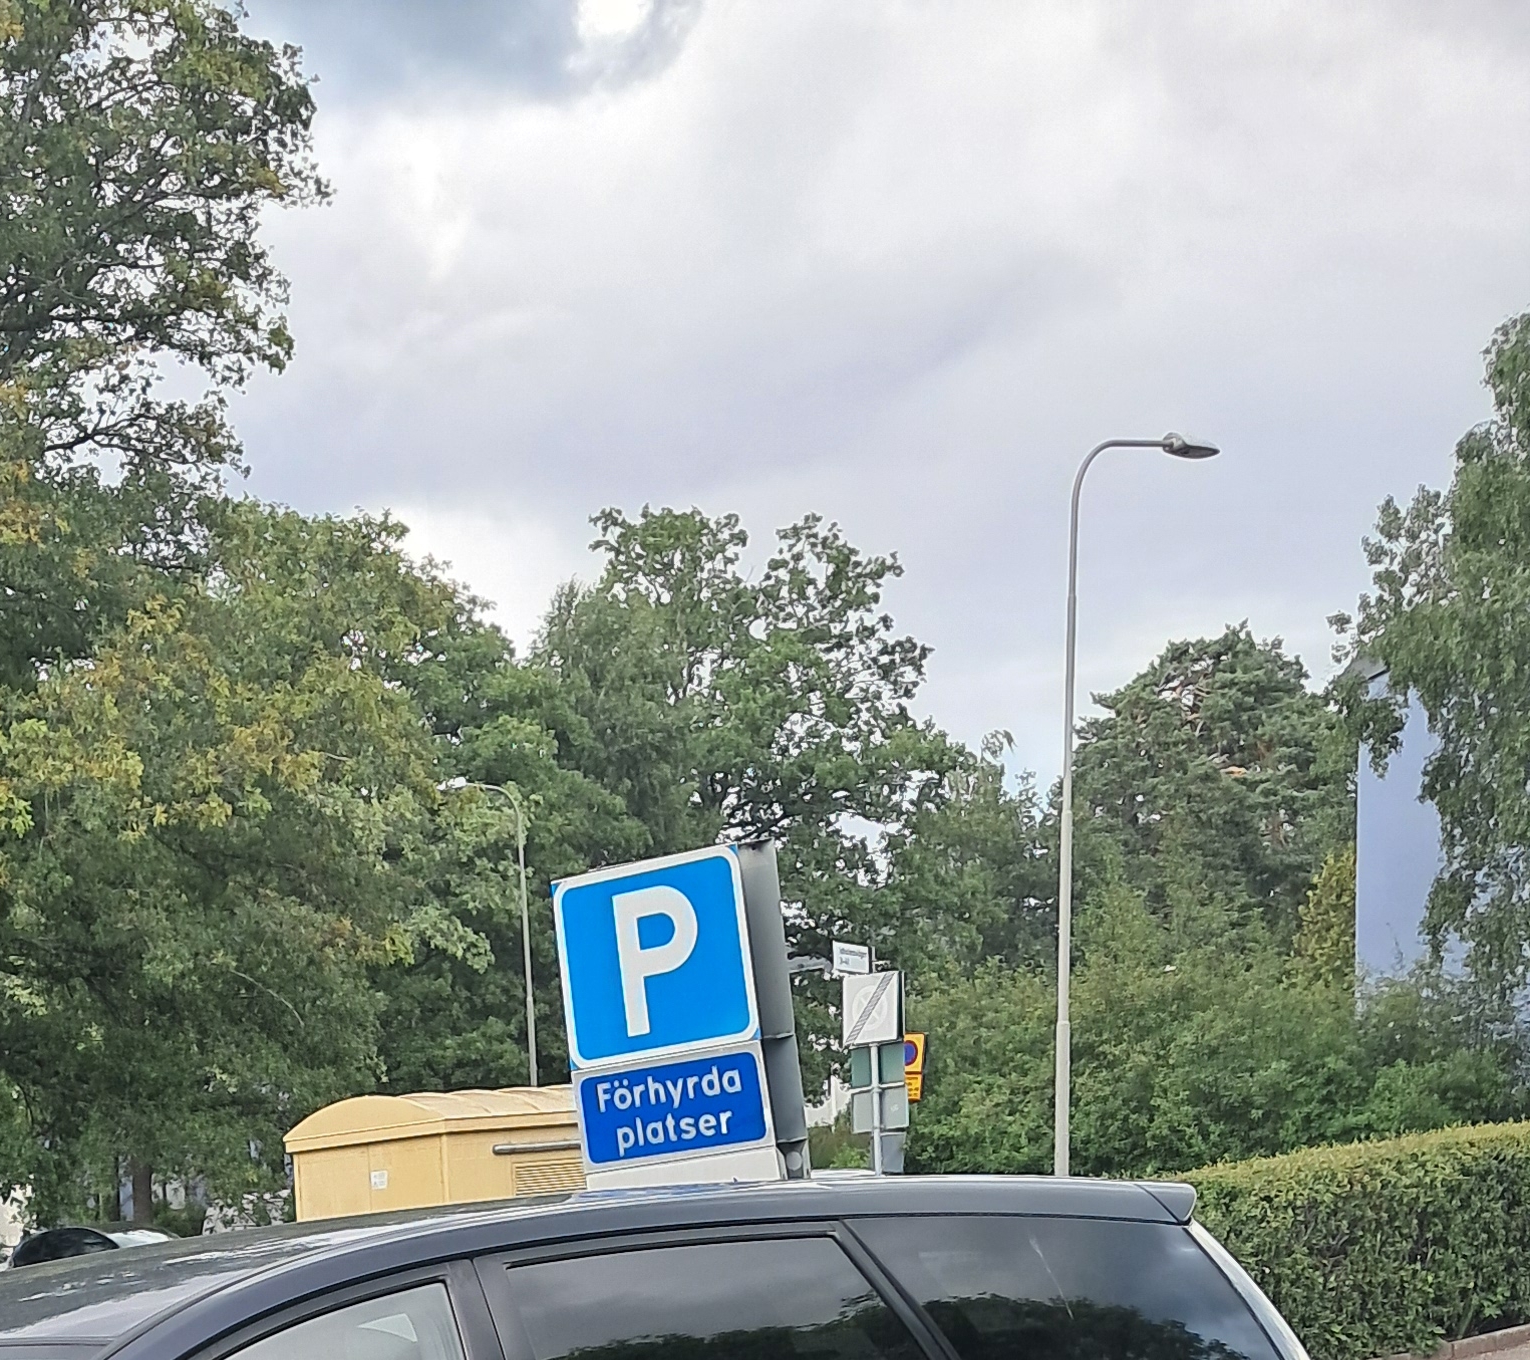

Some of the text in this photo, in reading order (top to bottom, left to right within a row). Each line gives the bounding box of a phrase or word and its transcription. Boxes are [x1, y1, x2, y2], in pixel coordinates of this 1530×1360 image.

[611, 885, 698, 1038] P
[596, 1065, 742, 1113] Förhyrda
[616, 1110, 732, 1157] platser
